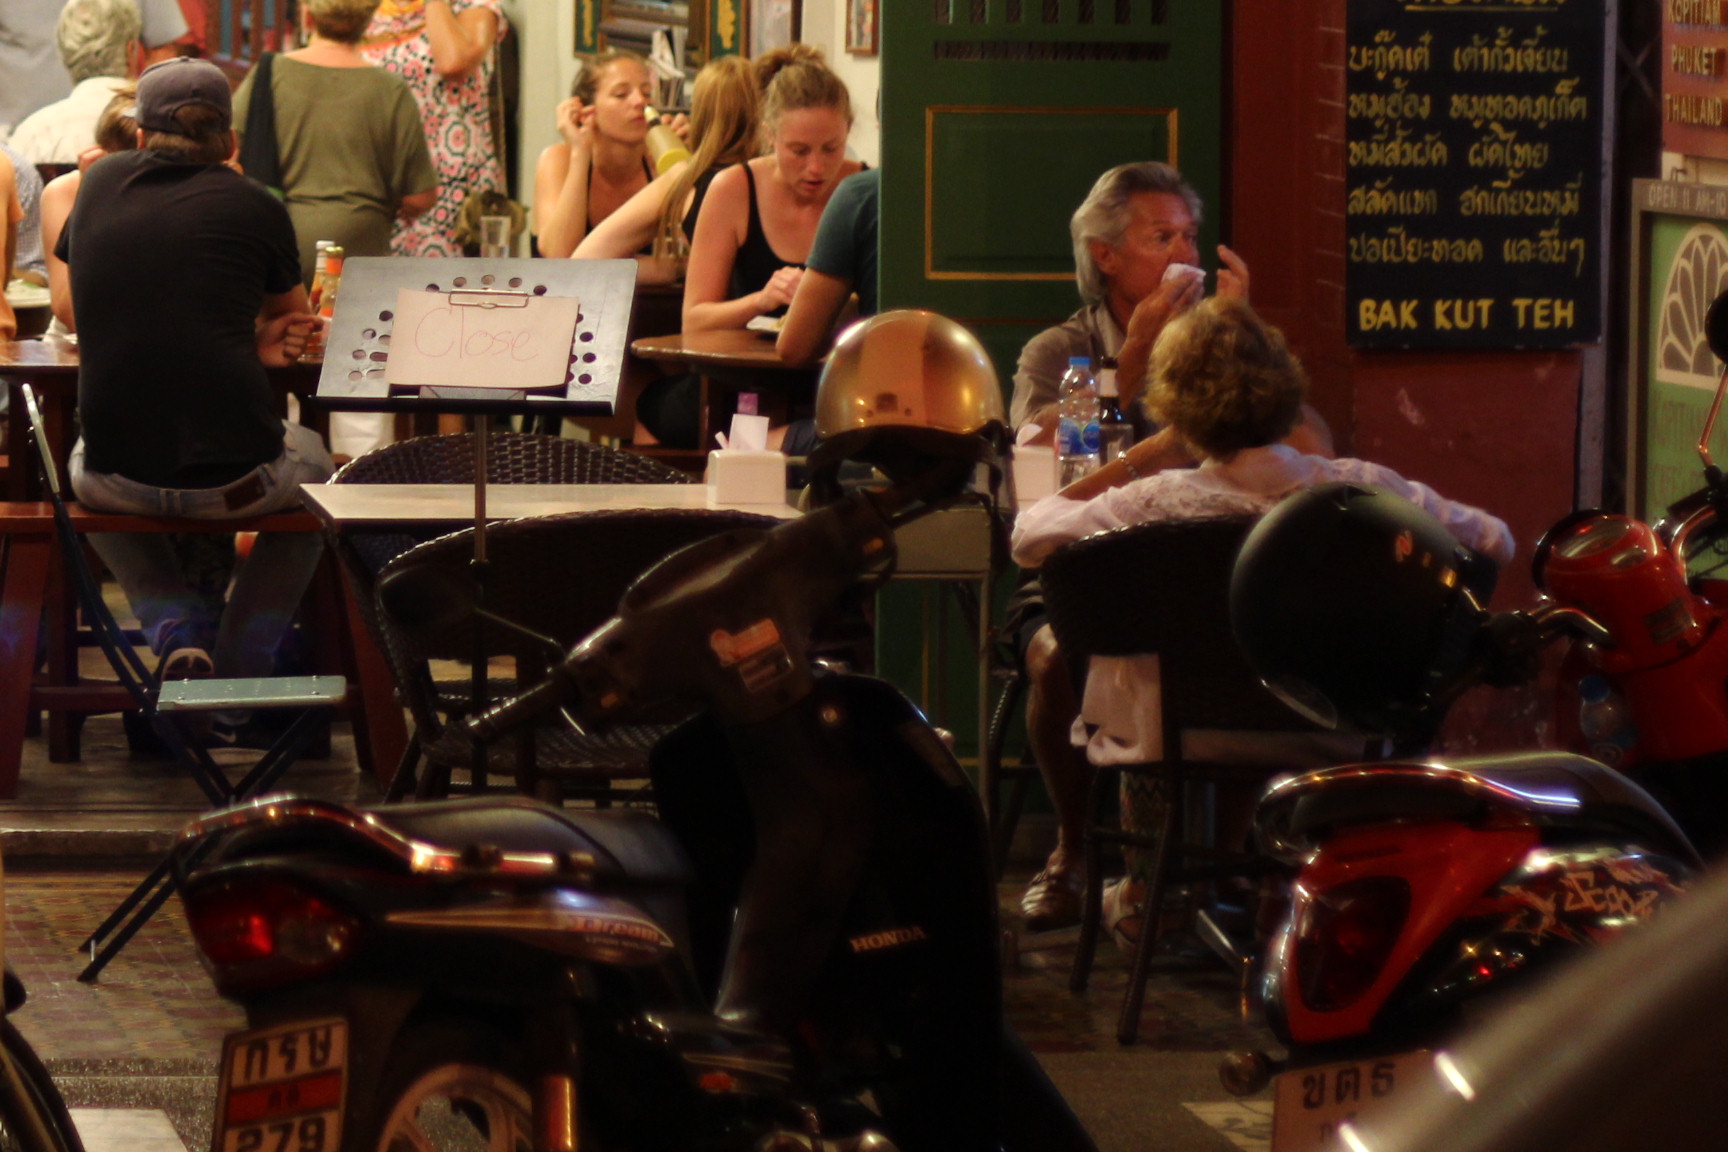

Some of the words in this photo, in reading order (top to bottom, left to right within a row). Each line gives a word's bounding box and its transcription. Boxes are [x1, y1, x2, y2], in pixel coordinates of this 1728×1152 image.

[1671, 44, 1717, 76] PHUKET
[1665, 93, 1723, 126] THAILAND
[1648, 185, 1677, 208] OPEN
[1358, 298, 1420, 331] BAK
[1434, 298, 1495, 330] KUT
[1512, 298, 1576, 330] TEH
[414, 305, 538, 362] Close
[848, 925, 928, 953] HONDA
